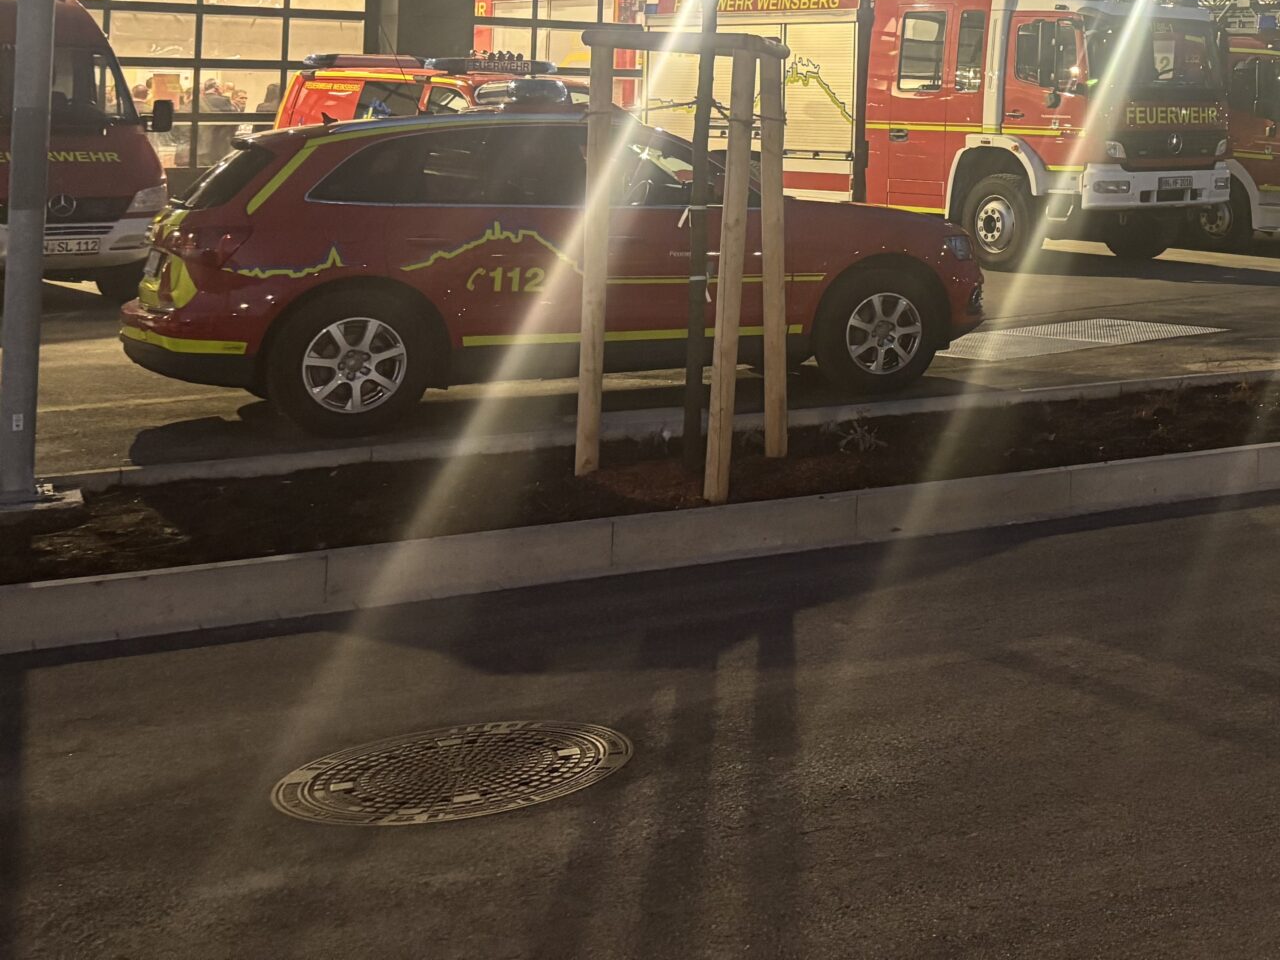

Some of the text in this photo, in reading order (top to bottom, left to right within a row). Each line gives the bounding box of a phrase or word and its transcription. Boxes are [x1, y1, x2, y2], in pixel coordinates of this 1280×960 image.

[1126, 106, 1218, 125] FEUERWEHR
[76, 241, 98, 252] 112
[489, 267, 545, 292] 112
